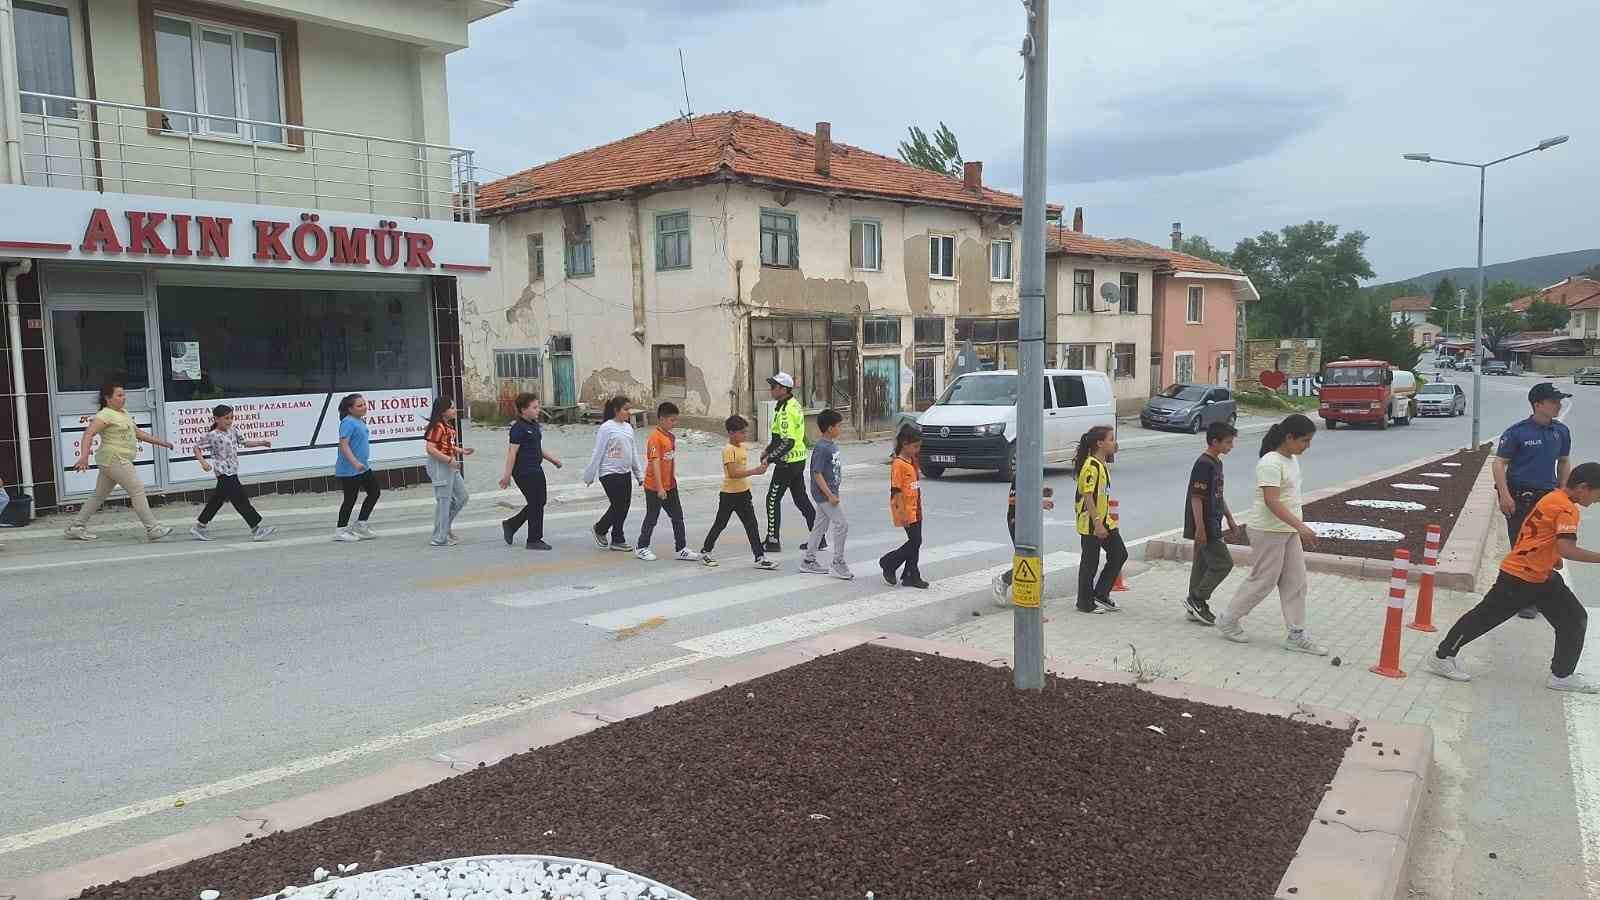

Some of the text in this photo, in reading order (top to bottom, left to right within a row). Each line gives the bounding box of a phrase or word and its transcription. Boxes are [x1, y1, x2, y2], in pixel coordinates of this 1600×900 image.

[80, 208, 436, 268] AKIN KÖMÜR
[258, 401, 312, 411] PAZARLAMA
[381, 395, 429, 411] KÖMÜR
[179, 416, 205, 425] SOMA
